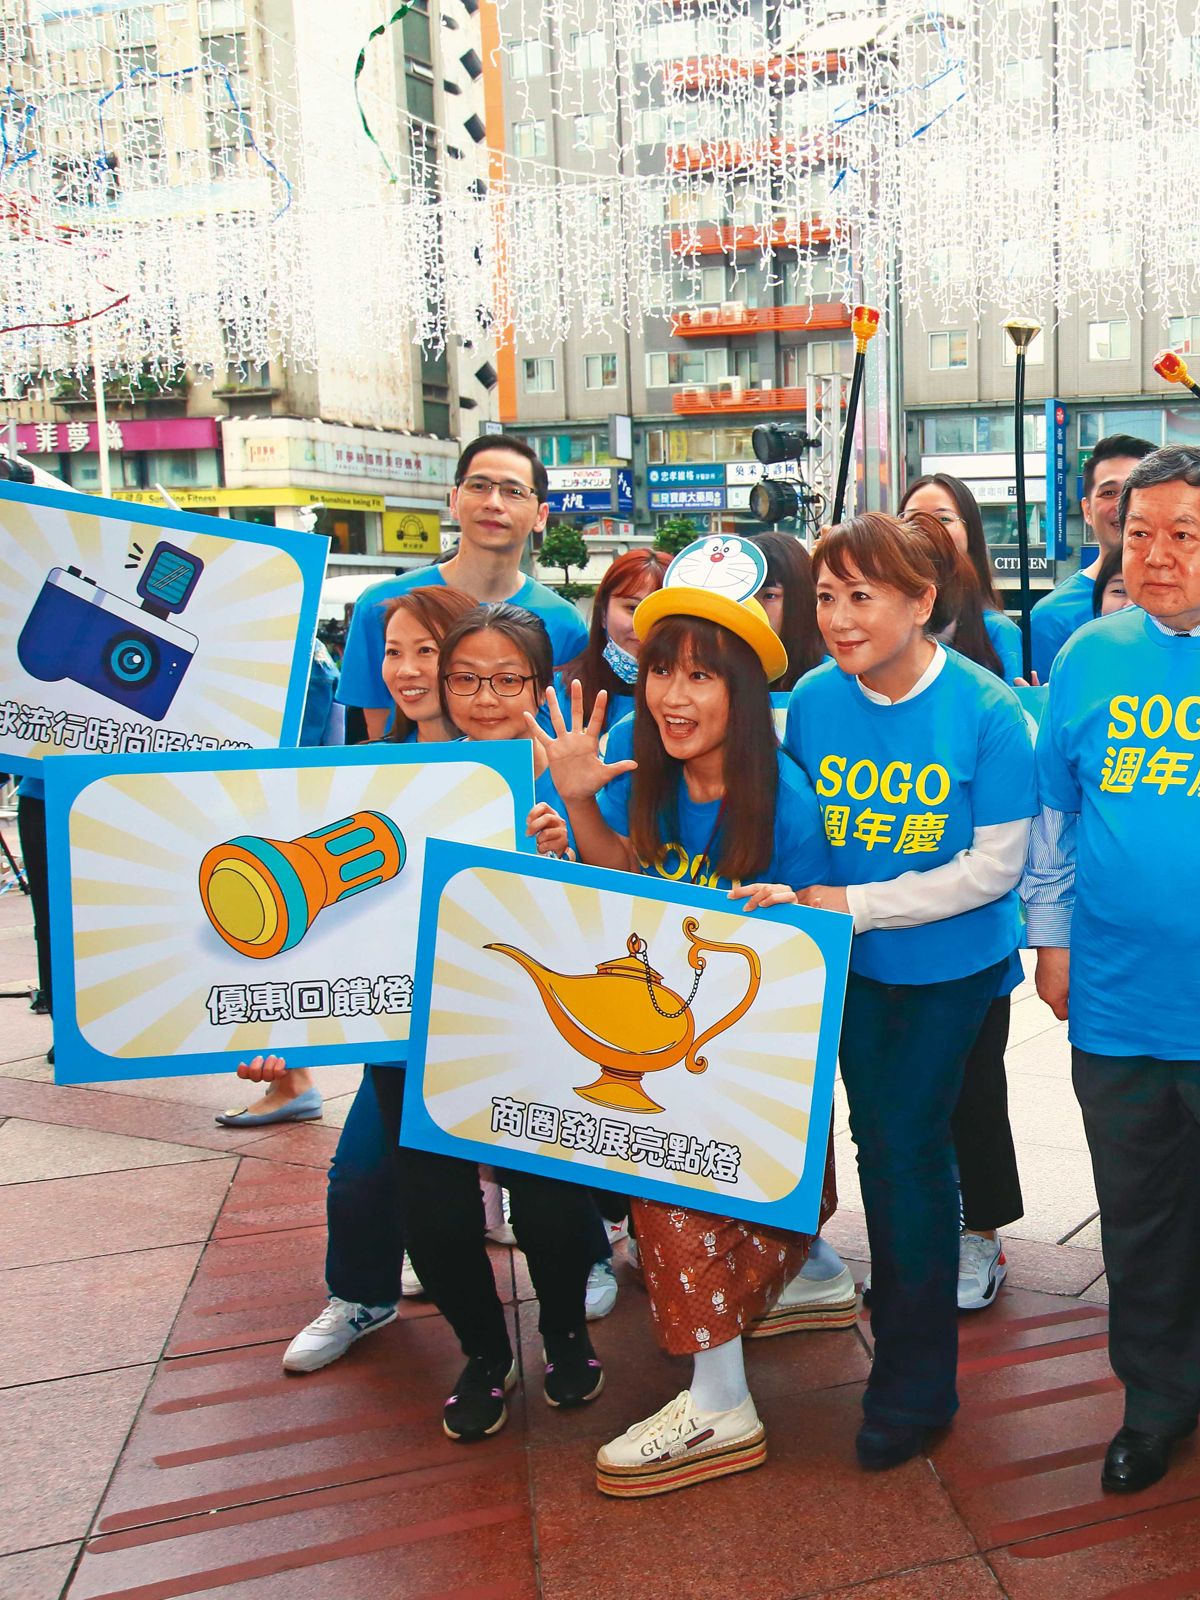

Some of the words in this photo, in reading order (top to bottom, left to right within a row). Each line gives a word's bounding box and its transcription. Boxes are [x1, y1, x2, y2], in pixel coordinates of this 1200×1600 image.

[148, 494, 185, 503] Sunine
[994, 557, 1048, 570] CITIEN
[0, 701, 253, 754] 球流行時尚照相
[816, 754, 951, 807] SOGO
[206, 974, 413, 1026] 優惠回饋燈
[490, 1096, 742, 1184] 商圈發展亮點燈
